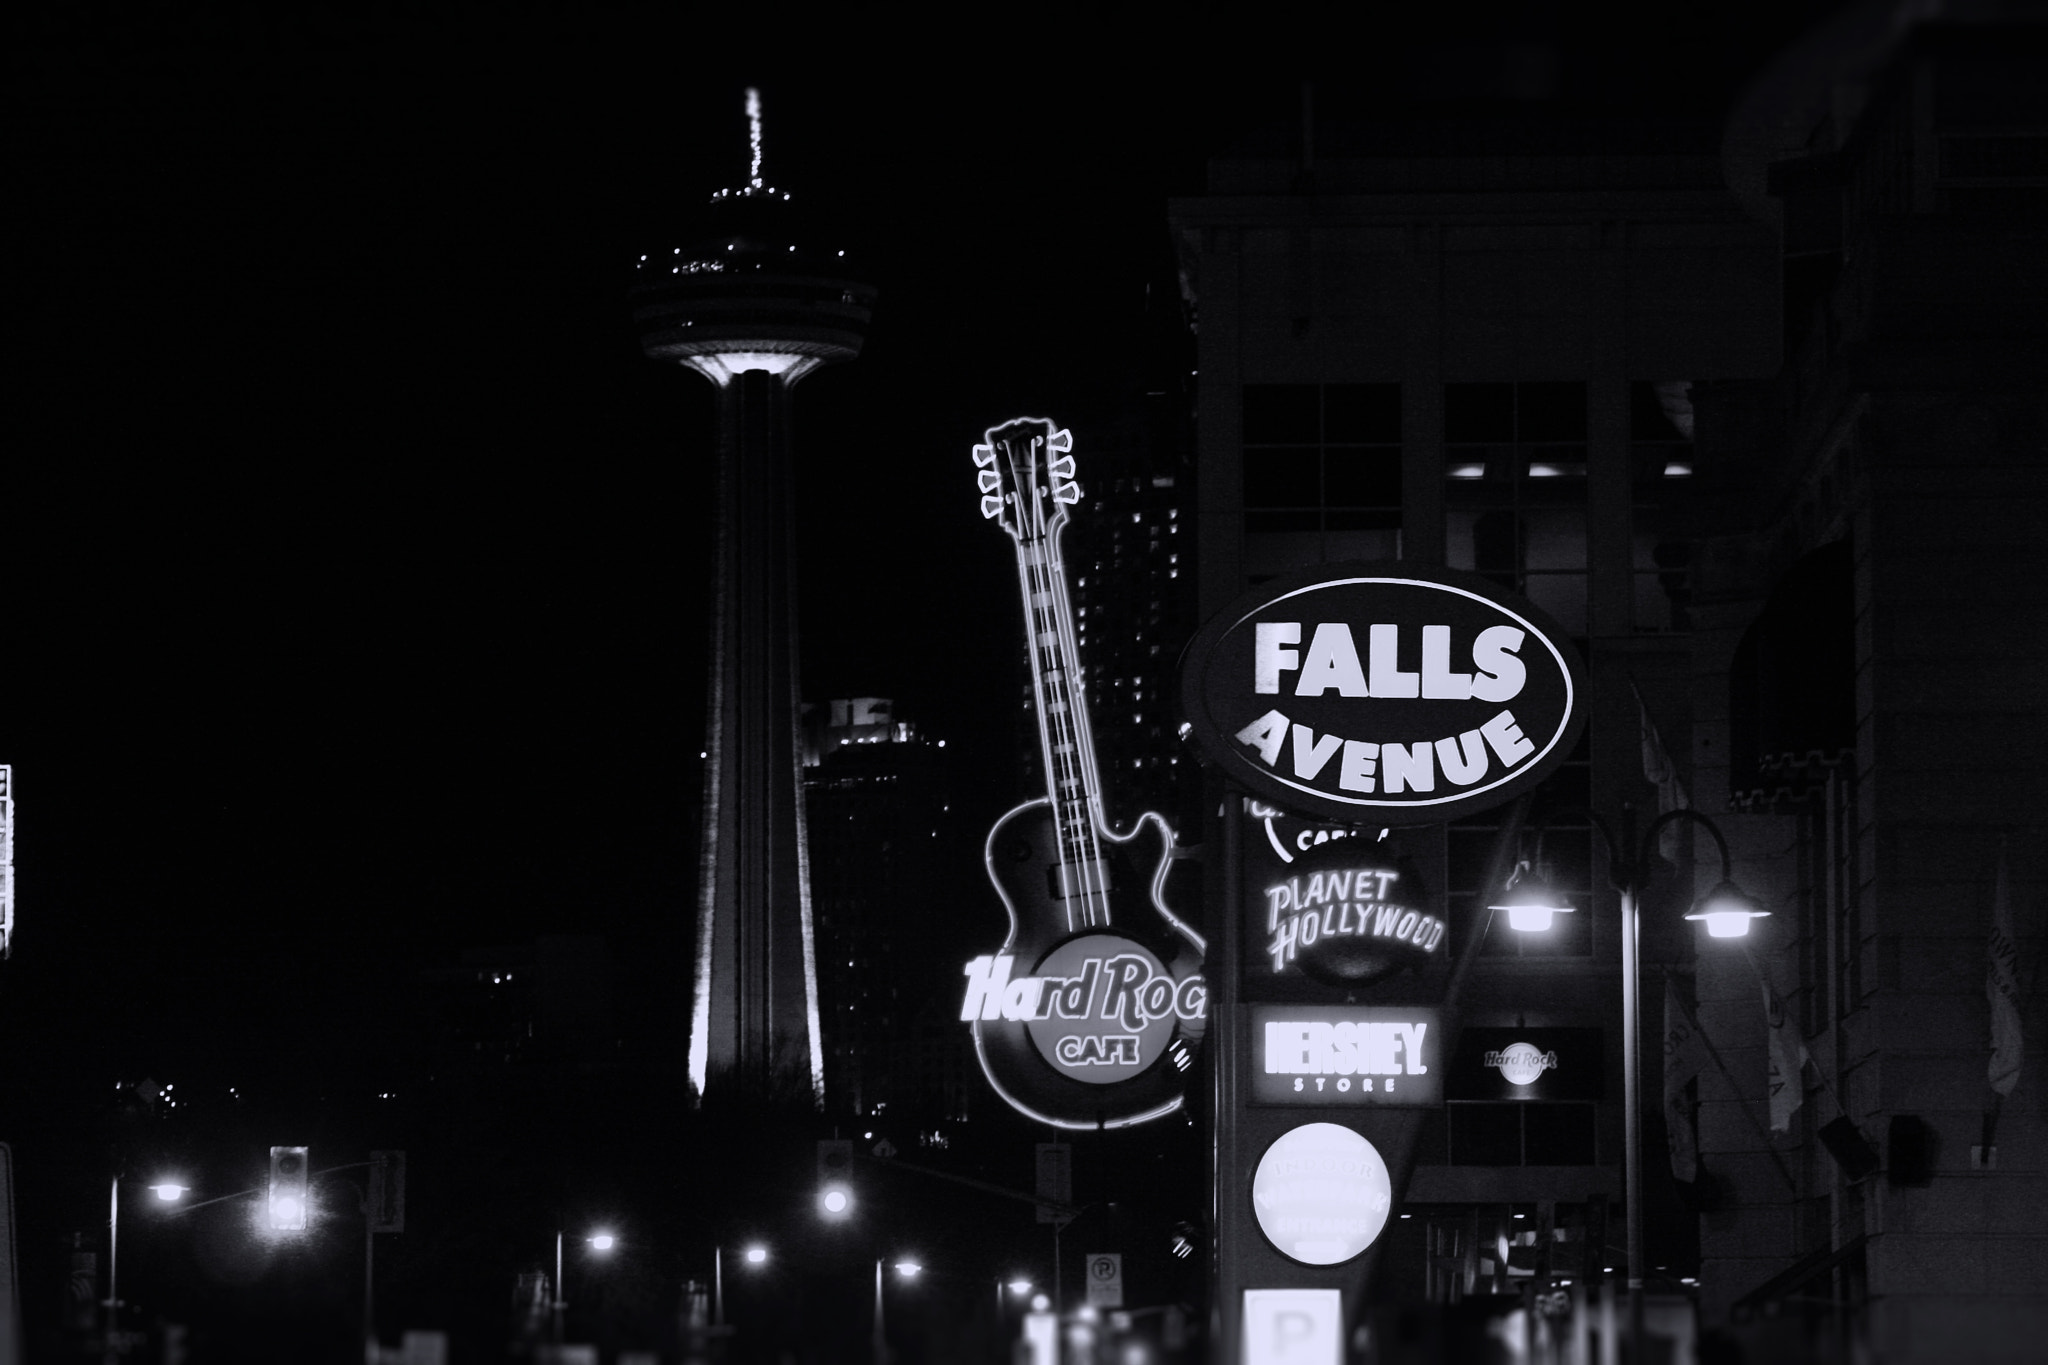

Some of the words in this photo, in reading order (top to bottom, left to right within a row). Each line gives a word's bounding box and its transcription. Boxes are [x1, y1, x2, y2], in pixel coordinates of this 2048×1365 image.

[1254, 622, 1527, 702] FALLS
[1234, 709, 1536, 794] AVENUE
[1264, 869, 1400, 934] PLANET
[1266, 904, 1446, 974] HOLLYWOOD
[960, 954, 1101, 1022] Hard
[1102, 953, 1208, 1033] Roc
[1055, 1036, 1141, 1067] CAFE
[1293, 1077, 1395, 1093] STORE
[1484, 1050, 1521, 1068] Hard
[1522, 1050, 1558, 1070] Rock
